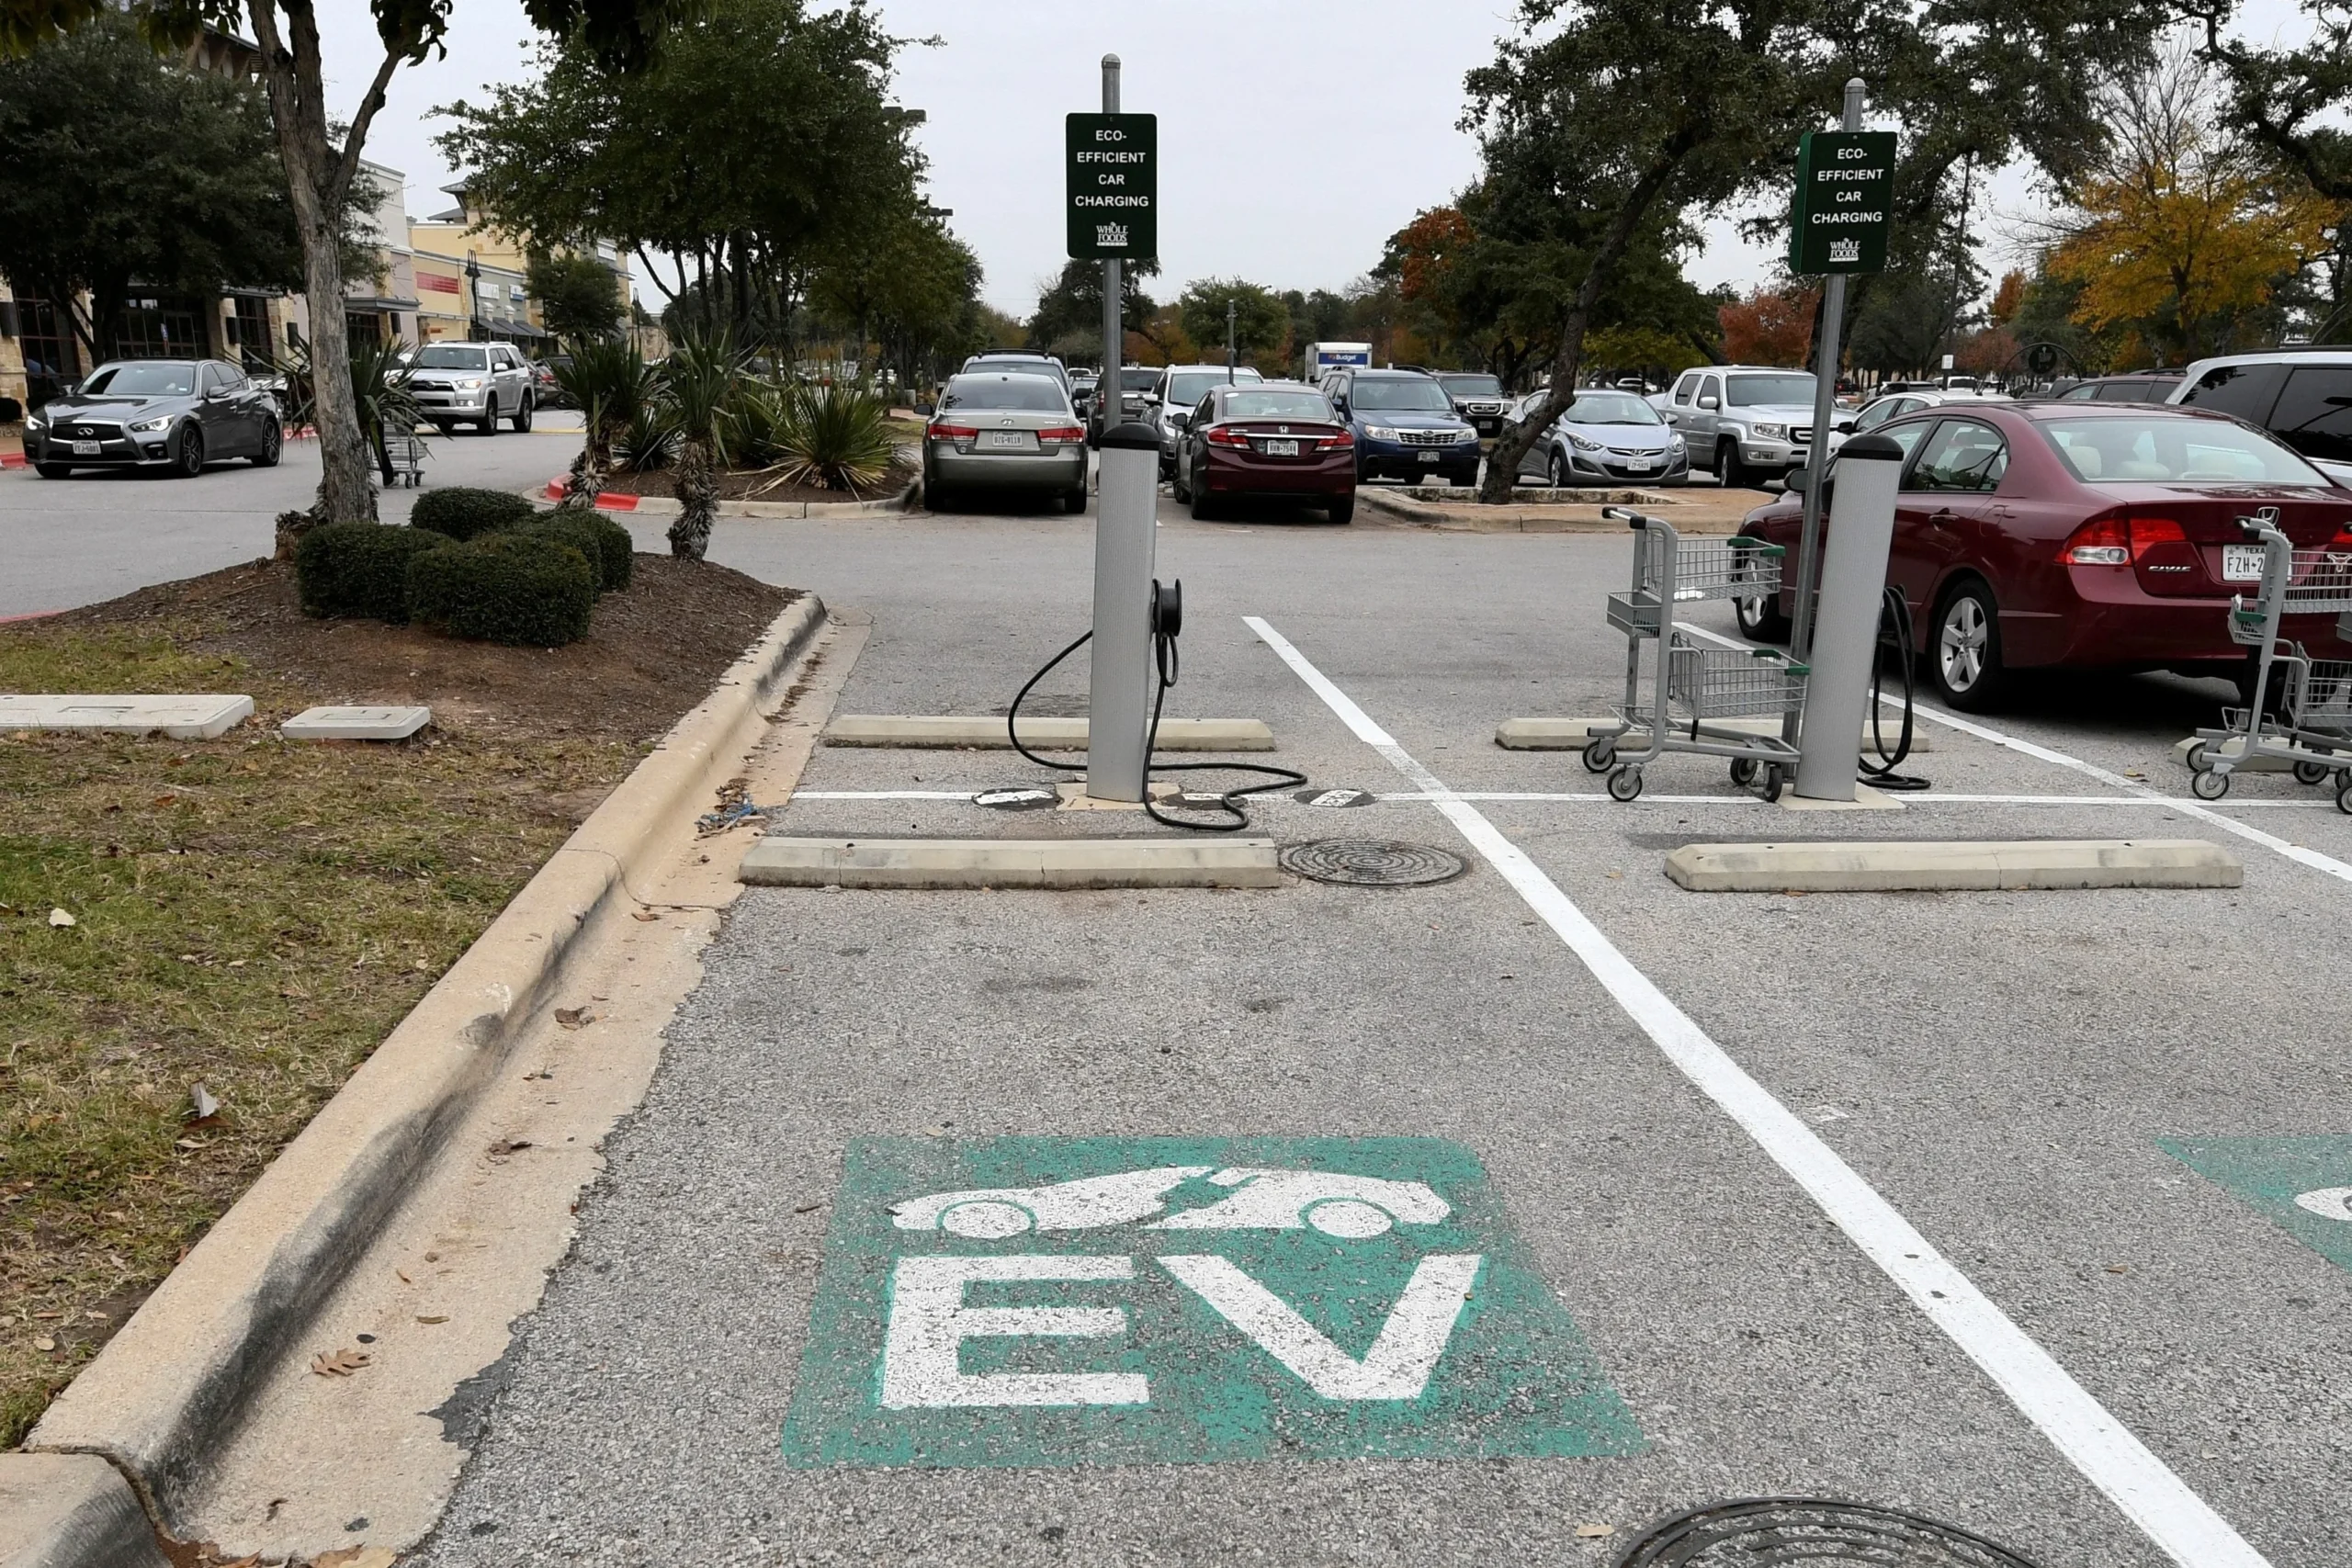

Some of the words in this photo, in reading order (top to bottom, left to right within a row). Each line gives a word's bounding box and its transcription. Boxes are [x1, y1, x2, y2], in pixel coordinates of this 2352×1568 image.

[1095, 130, 1127, 141] ECO-
[1077, 152, 1146, 163] EFFICIENT
[1837, 148, 1868, 160] ECO-
[1098, 174, 1125, 185] CAR
[1817, 168, 1884, 181] EFFICIENT
[1075, 196, 1149, 207] CHARGING
[1836, 191, 1861, 202] CAR
[1812, 211, 1883, 224] CHARGING
[1096, 225, 1128, 234] WHOLE
[1098, 233, 1127, 243] FOODS
[1829, 241, 1860, 250] WHOLE
[1830, 249, 1859, 258] FOODS
[1336, 354, 1357, 362] Budget
[880, 1253, 1484, 1407] EV
